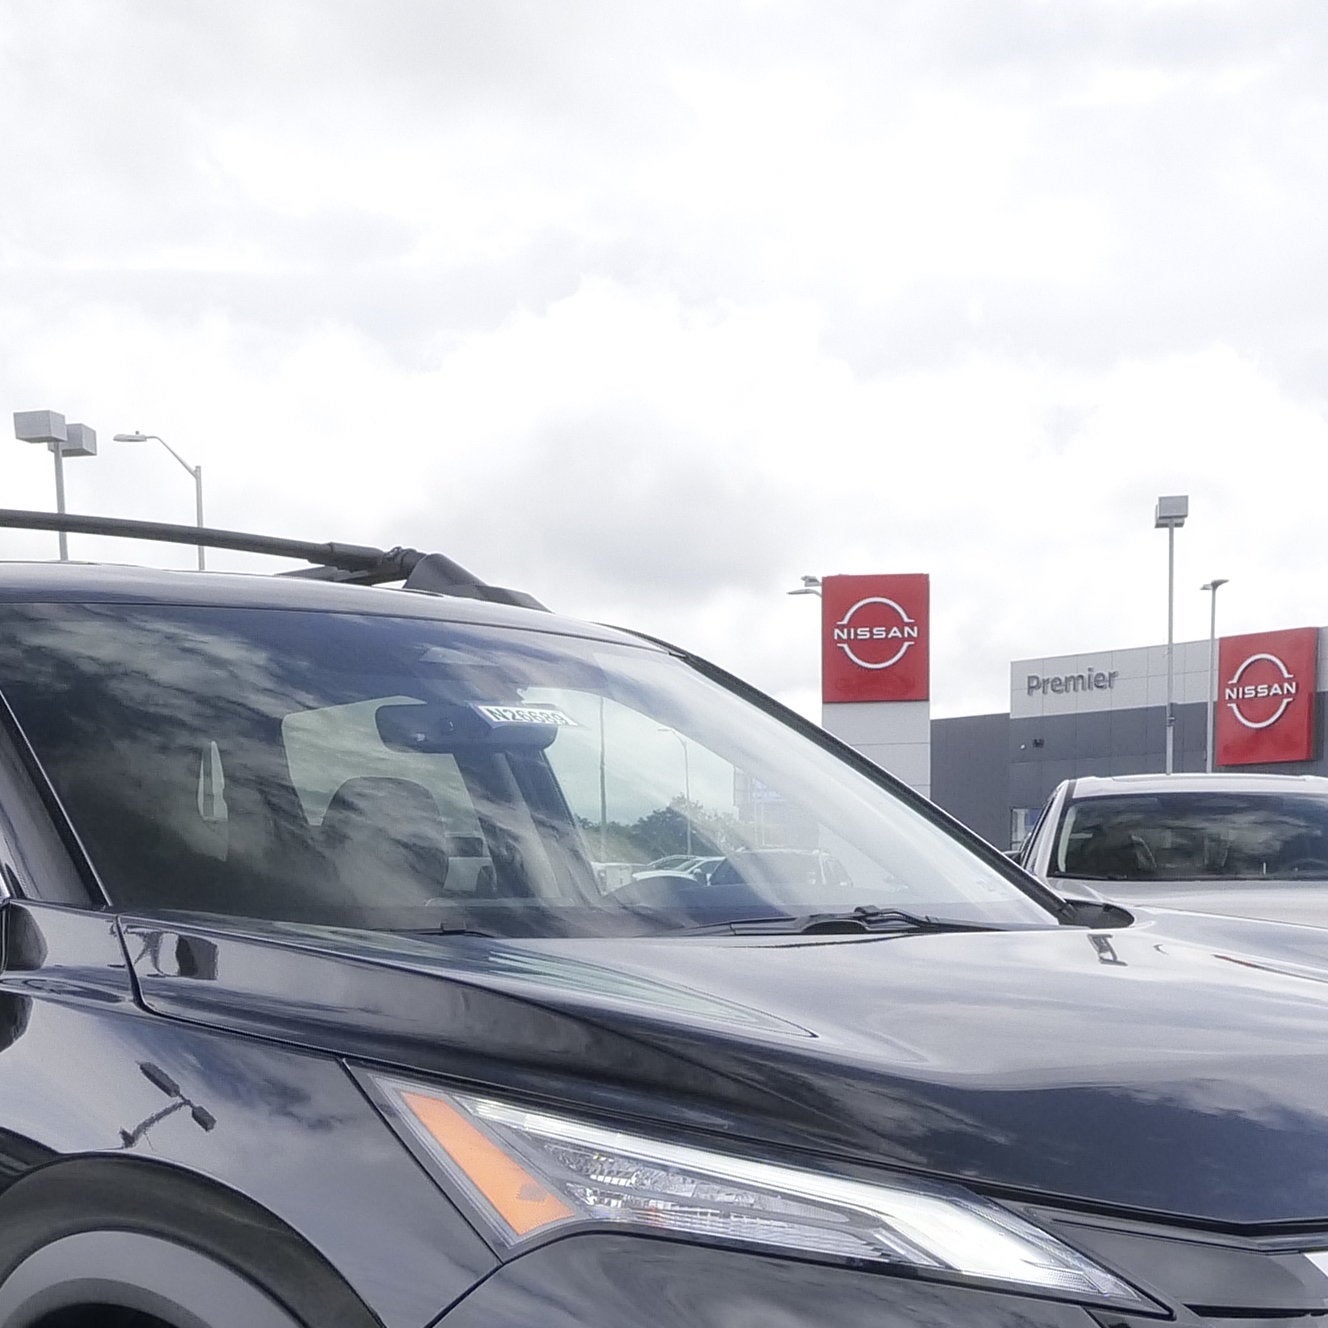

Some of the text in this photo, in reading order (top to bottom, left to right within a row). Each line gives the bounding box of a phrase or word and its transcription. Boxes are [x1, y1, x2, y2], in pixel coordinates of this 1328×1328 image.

[833, 625, 918, 640] NISSAN
[1026, 667, 1119, 696] Premier
[1224, 681, 1297, 701] NISSAN
